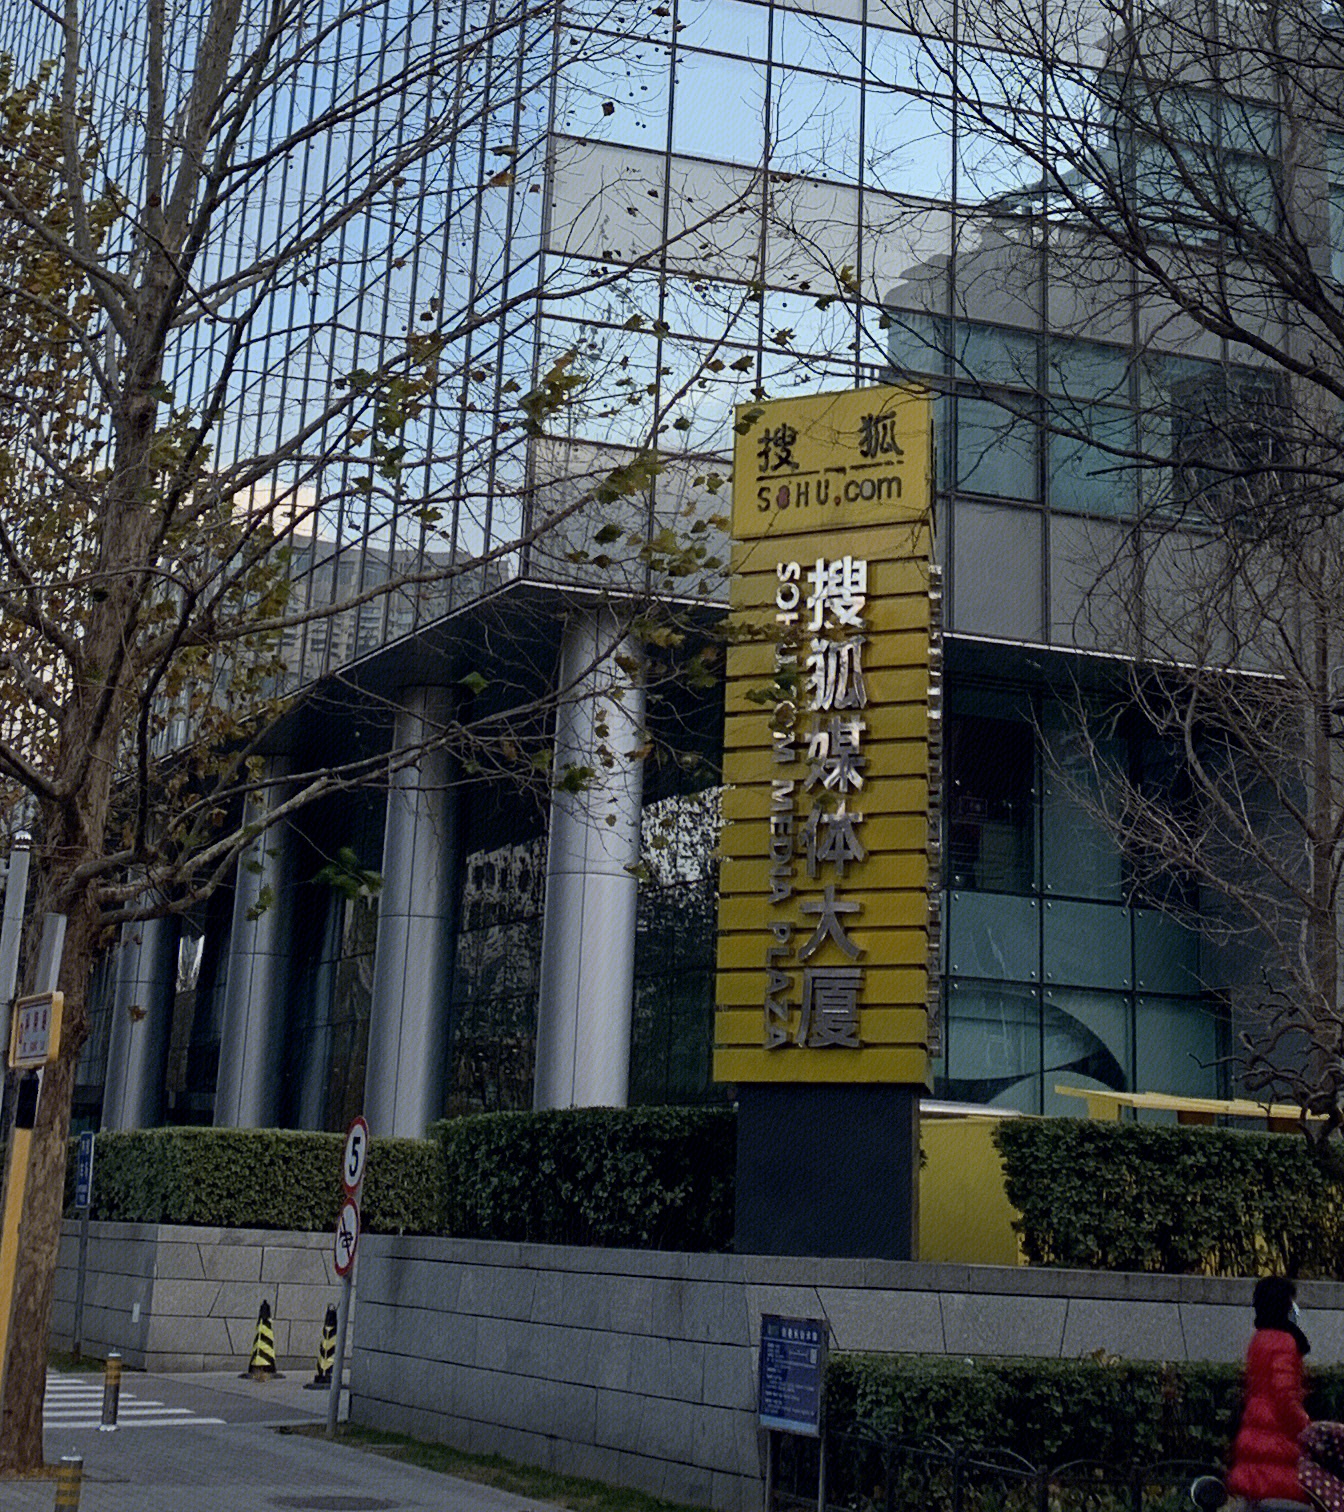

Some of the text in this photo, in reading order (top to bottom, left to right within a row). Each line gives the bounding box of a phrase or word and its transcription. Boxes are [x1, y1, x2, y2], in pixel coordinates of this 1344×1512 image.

[757, 411, 904, 473] 搜狐
[757, 476, 902, 512] SOHU.com
[769, 779, 795, 905] MEDIA
[799, 555, 868, 1049] 搜狐媒体大厦
[764, 922, 794, 1050] PLAZA
[349, 1136, 361, 1177] 5
